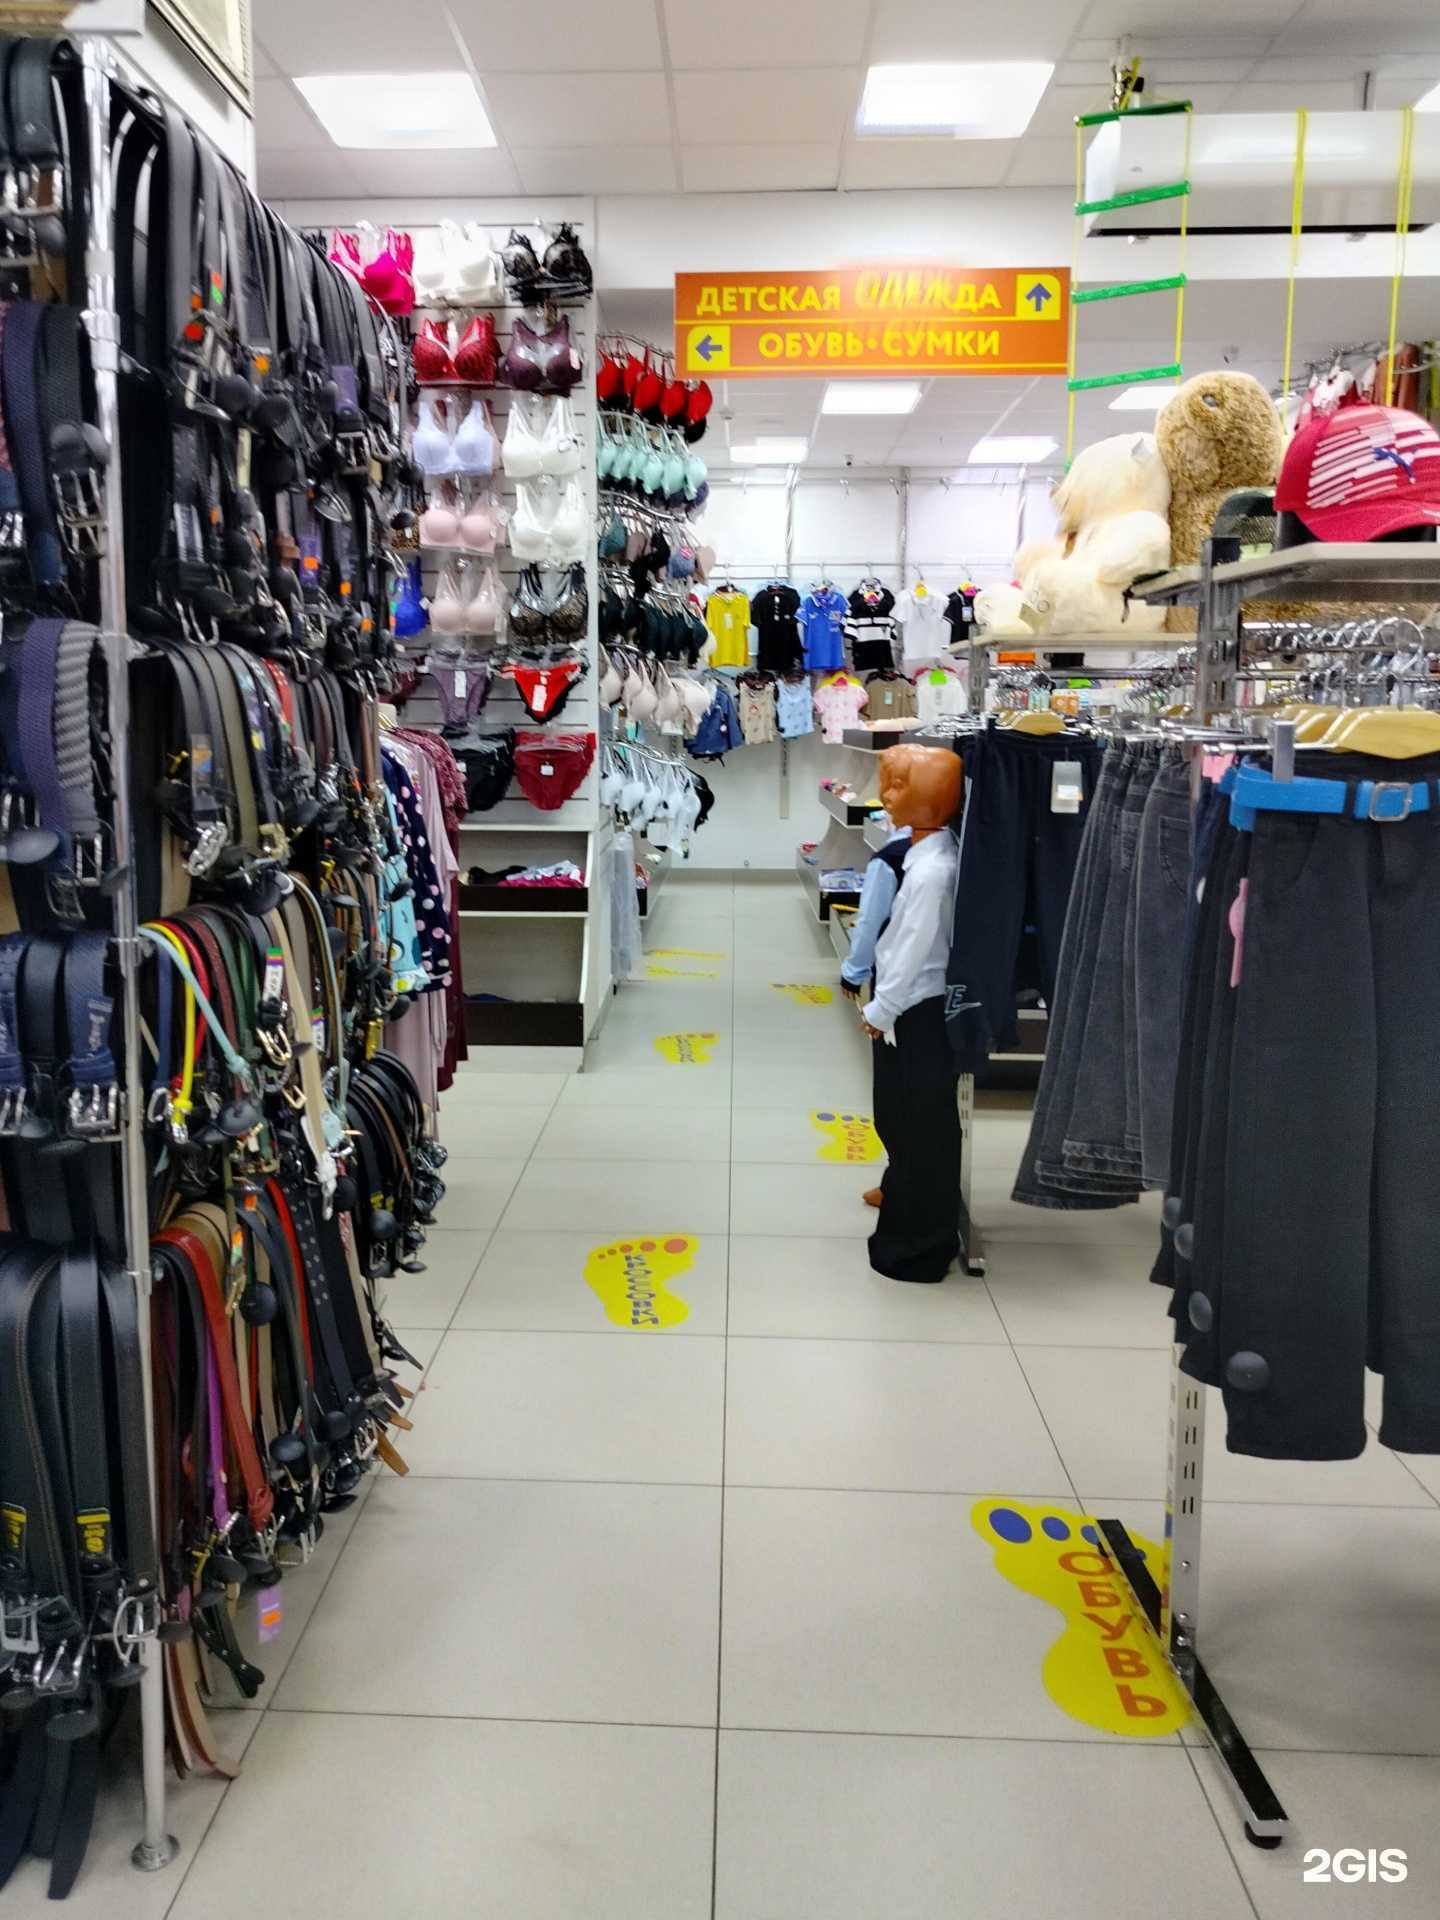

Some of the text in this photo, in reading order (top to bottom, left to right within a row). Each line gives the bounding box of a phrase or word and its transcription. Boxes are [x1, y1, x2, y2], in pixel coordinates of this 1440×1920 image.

[696, 270, 1001, 315] ДЕТСКАЯ ОДЕЖДА
[758, 325, 1000, 358] ОБУВЬ СУМКИ
[1058, 1551, 1168, 1718] ОБУВЬ
